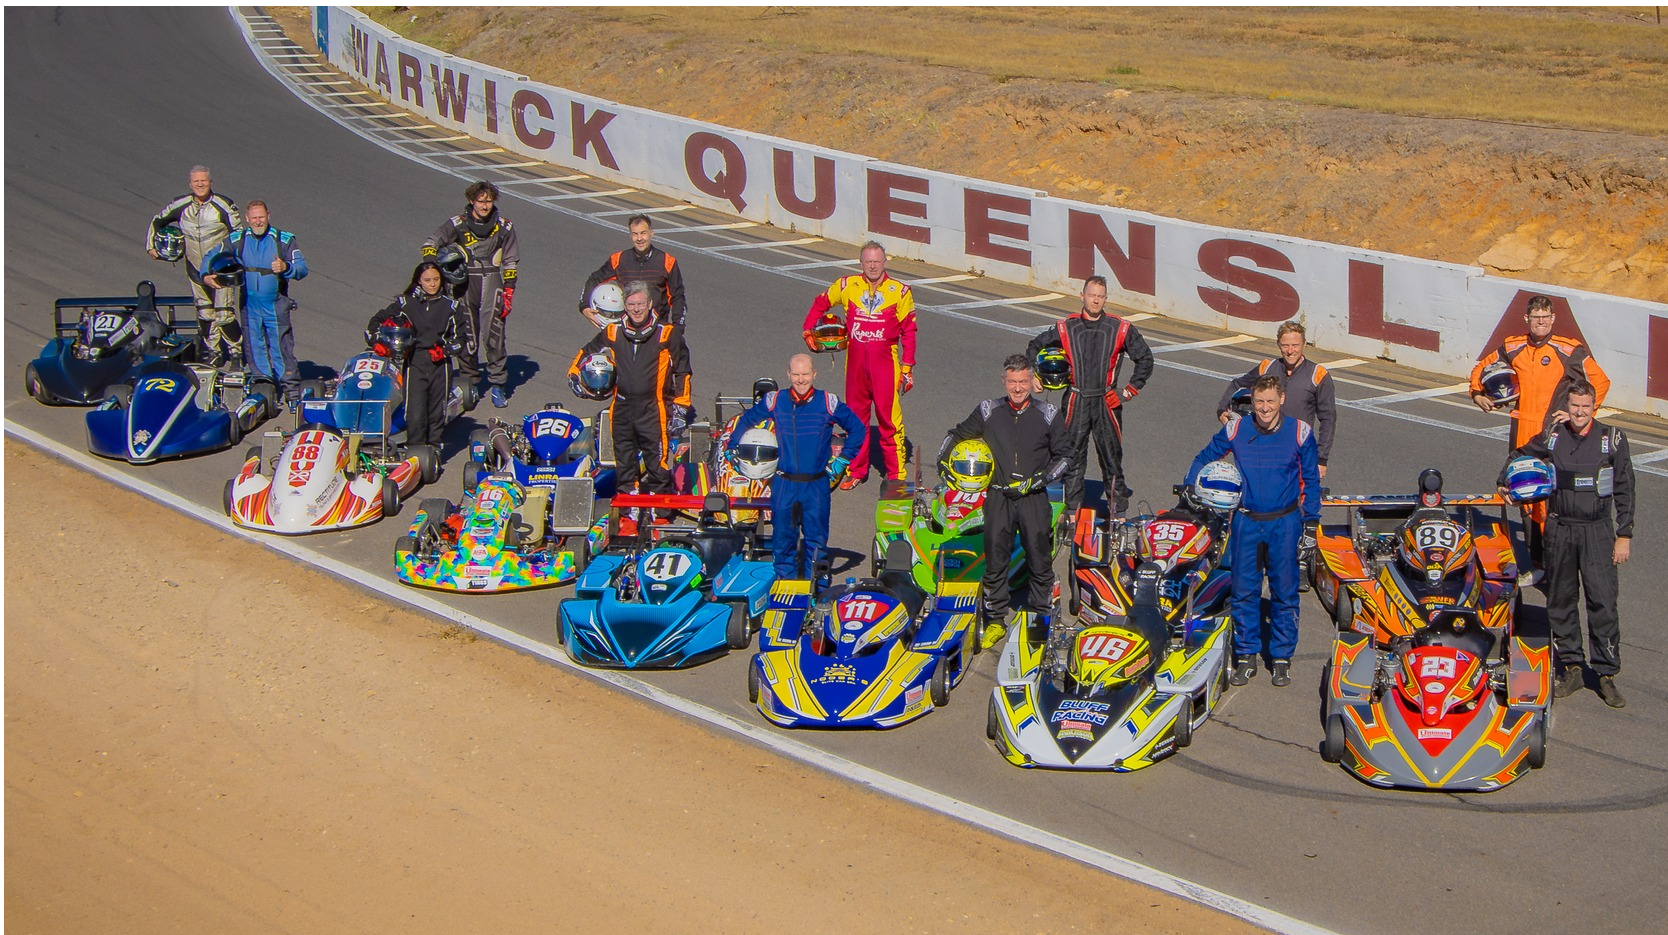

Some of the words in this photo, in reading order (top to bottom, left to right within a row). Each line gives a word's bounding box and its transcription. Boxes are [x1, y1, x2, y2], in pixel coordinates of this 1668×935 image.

[350, 23, 620, 172] WARWICK
[684, 131, 1668, 400] QUEENSLA
[96, 316, 116, 329] 21
[358, 360, 380, 371] 25
[145, 377, 177, 393] 72
[536, 417, 569, 438] 26
[292, 445, 320, 461] 88
[481, 489, 504, 501] 16
[1153, 524, 1185, 541] 35
[1419, 527, 1457, 549] 89
[646, 553, 682, 577] 41
[844, 601, 878, 620] 111
[1081, 635, 1130, 661] 46
[1420, 656, 1457, 679] 23
[1058, 699, 1111, 712] BLUFF
[1051, 710, 1109, 726] RACING
